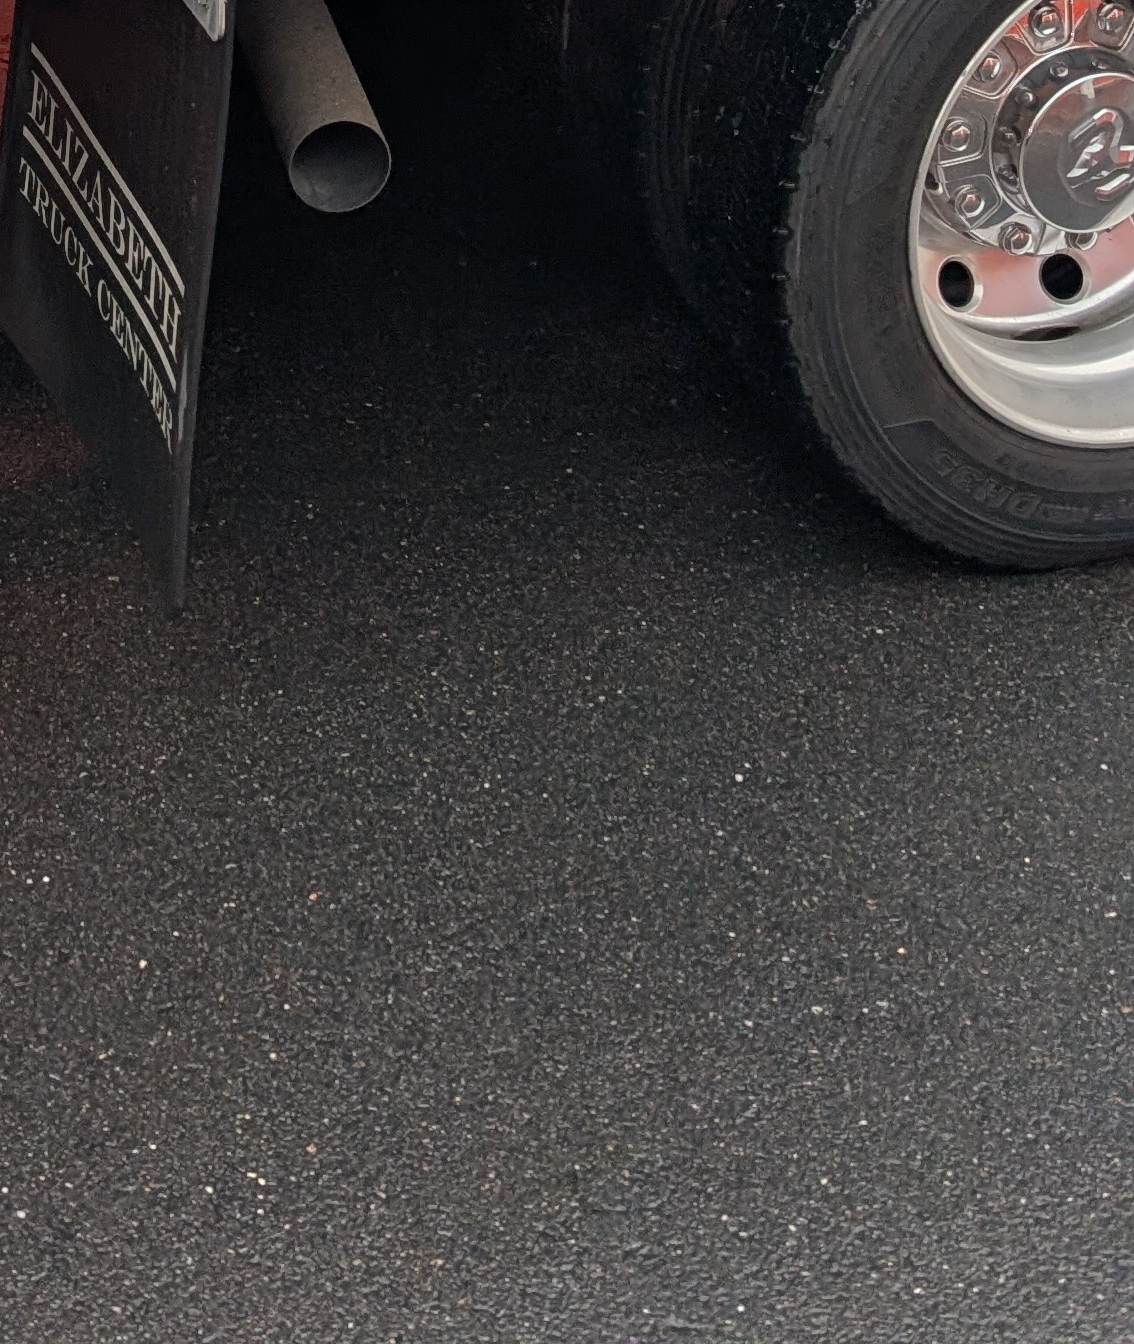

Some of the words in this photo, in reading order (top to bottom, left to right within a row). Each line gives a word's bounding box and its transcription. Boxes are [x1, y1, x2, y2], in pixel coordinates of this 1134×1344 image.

[19, 156, 94, 298] TRUCK
[97, 278, 173, 454] CENTER
[28, 69, 182, 364] ELIZABETH
